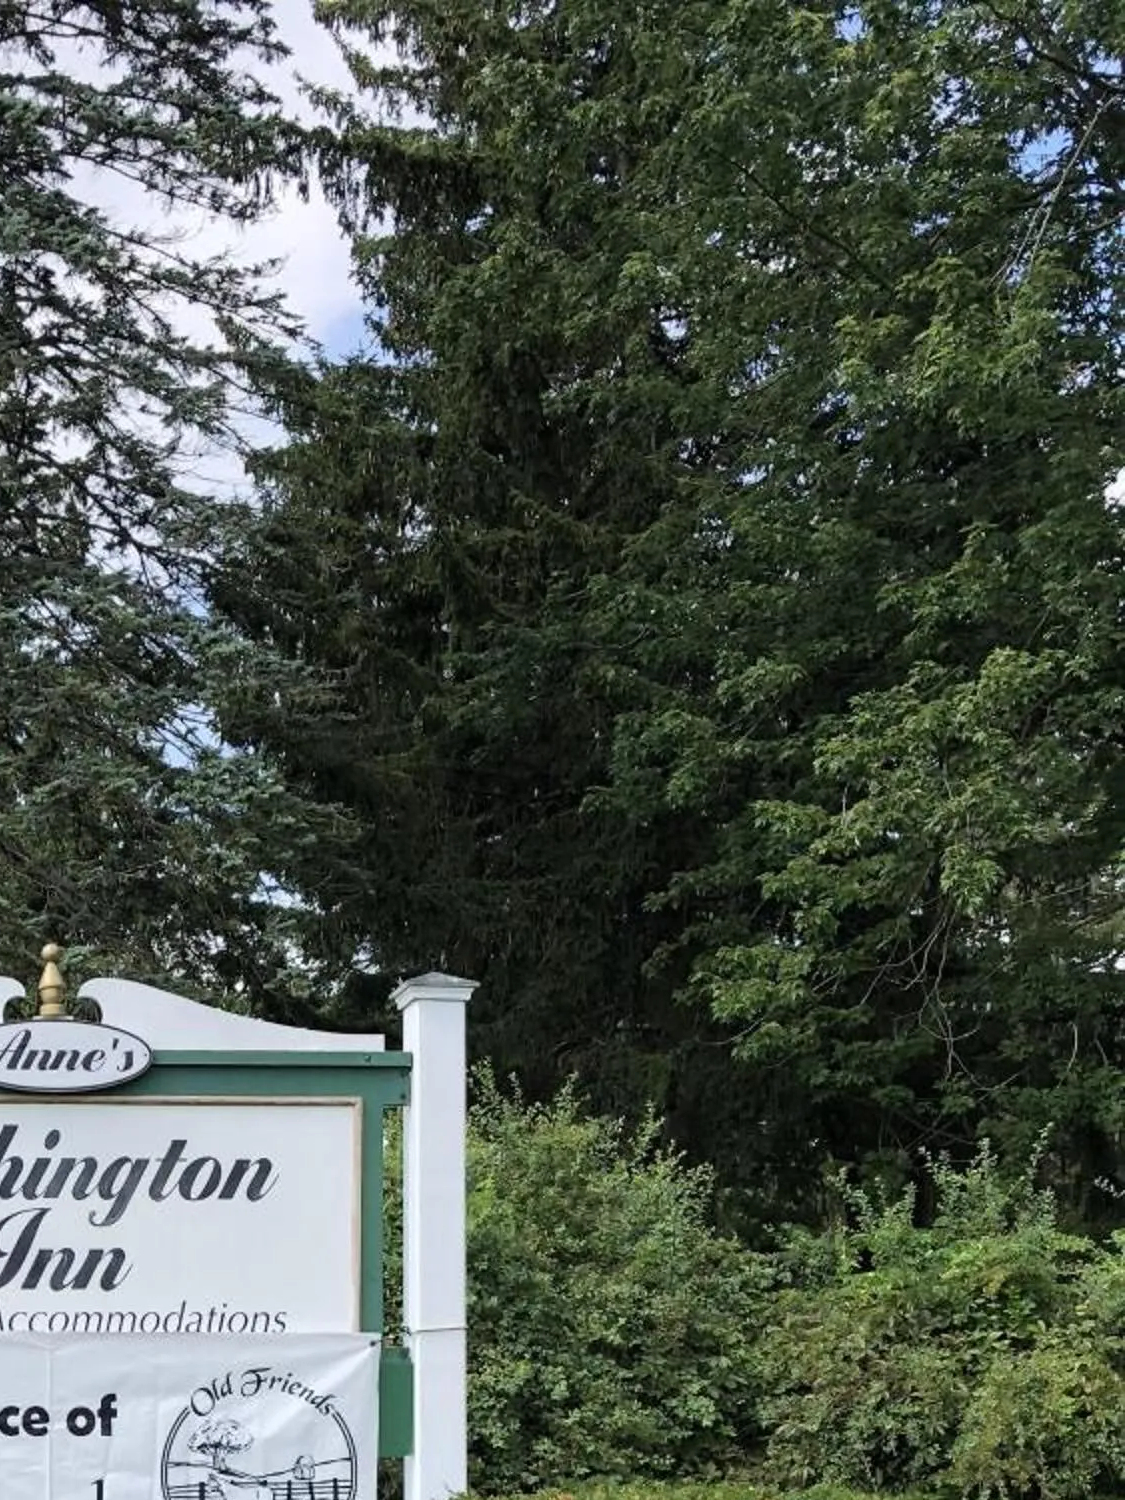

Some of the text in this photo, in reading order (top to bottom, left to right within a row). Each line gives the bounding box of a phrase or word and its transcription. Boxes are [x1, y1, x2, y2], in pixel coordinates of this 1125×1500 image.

[190, 1367, 337, 1416] Old Friends
[65, 1393, 118, 1437] of
